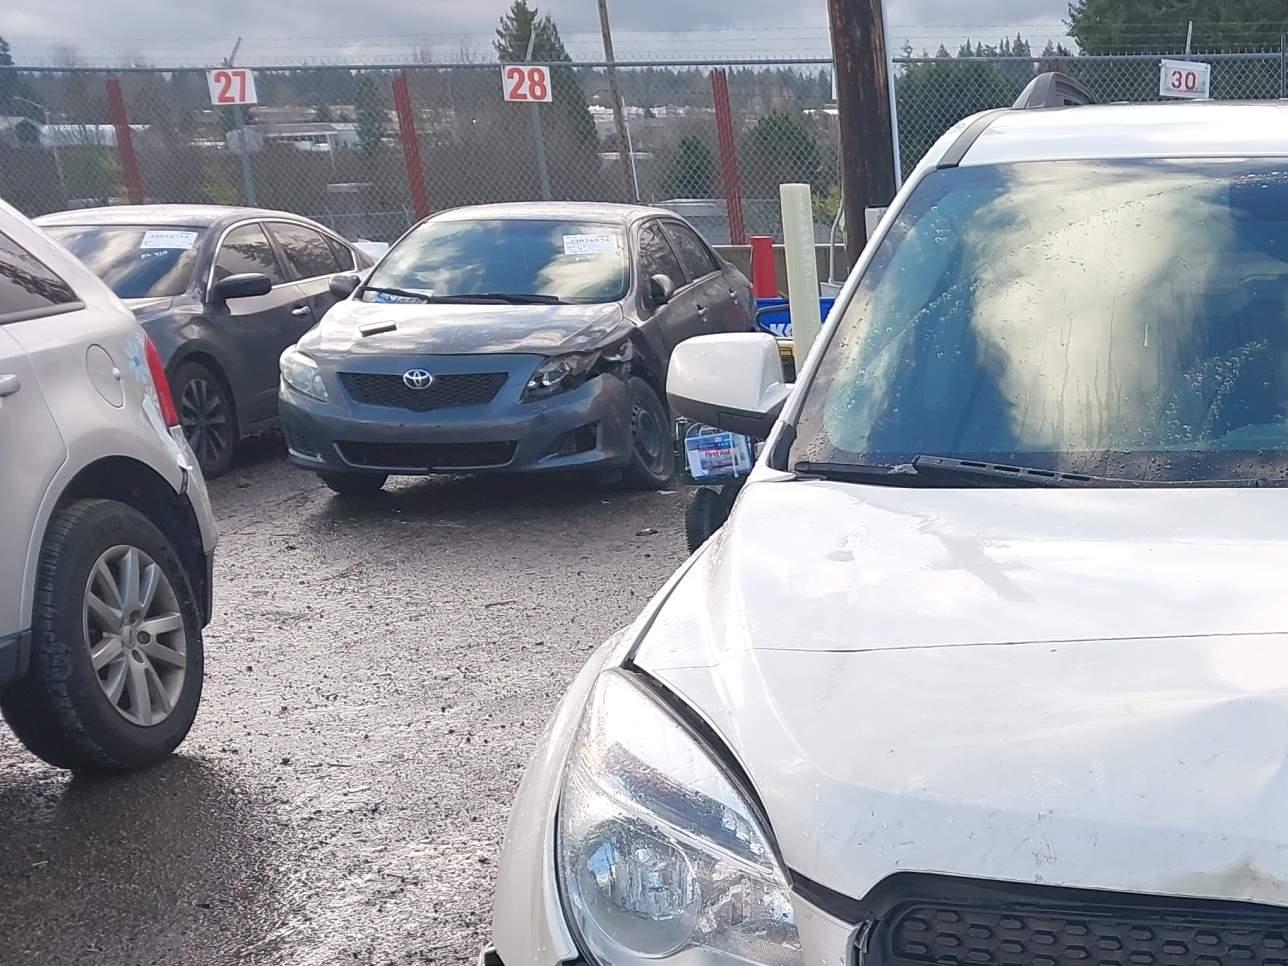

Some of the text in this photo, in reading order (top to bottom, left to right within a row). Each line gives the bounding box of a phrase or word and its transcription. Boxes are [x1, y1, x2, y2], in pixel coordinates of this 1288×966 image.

[213, 71, 246, 103] 27
[507, 67, 547, 100] 28
[1171, 70, 1196, 90] 30
